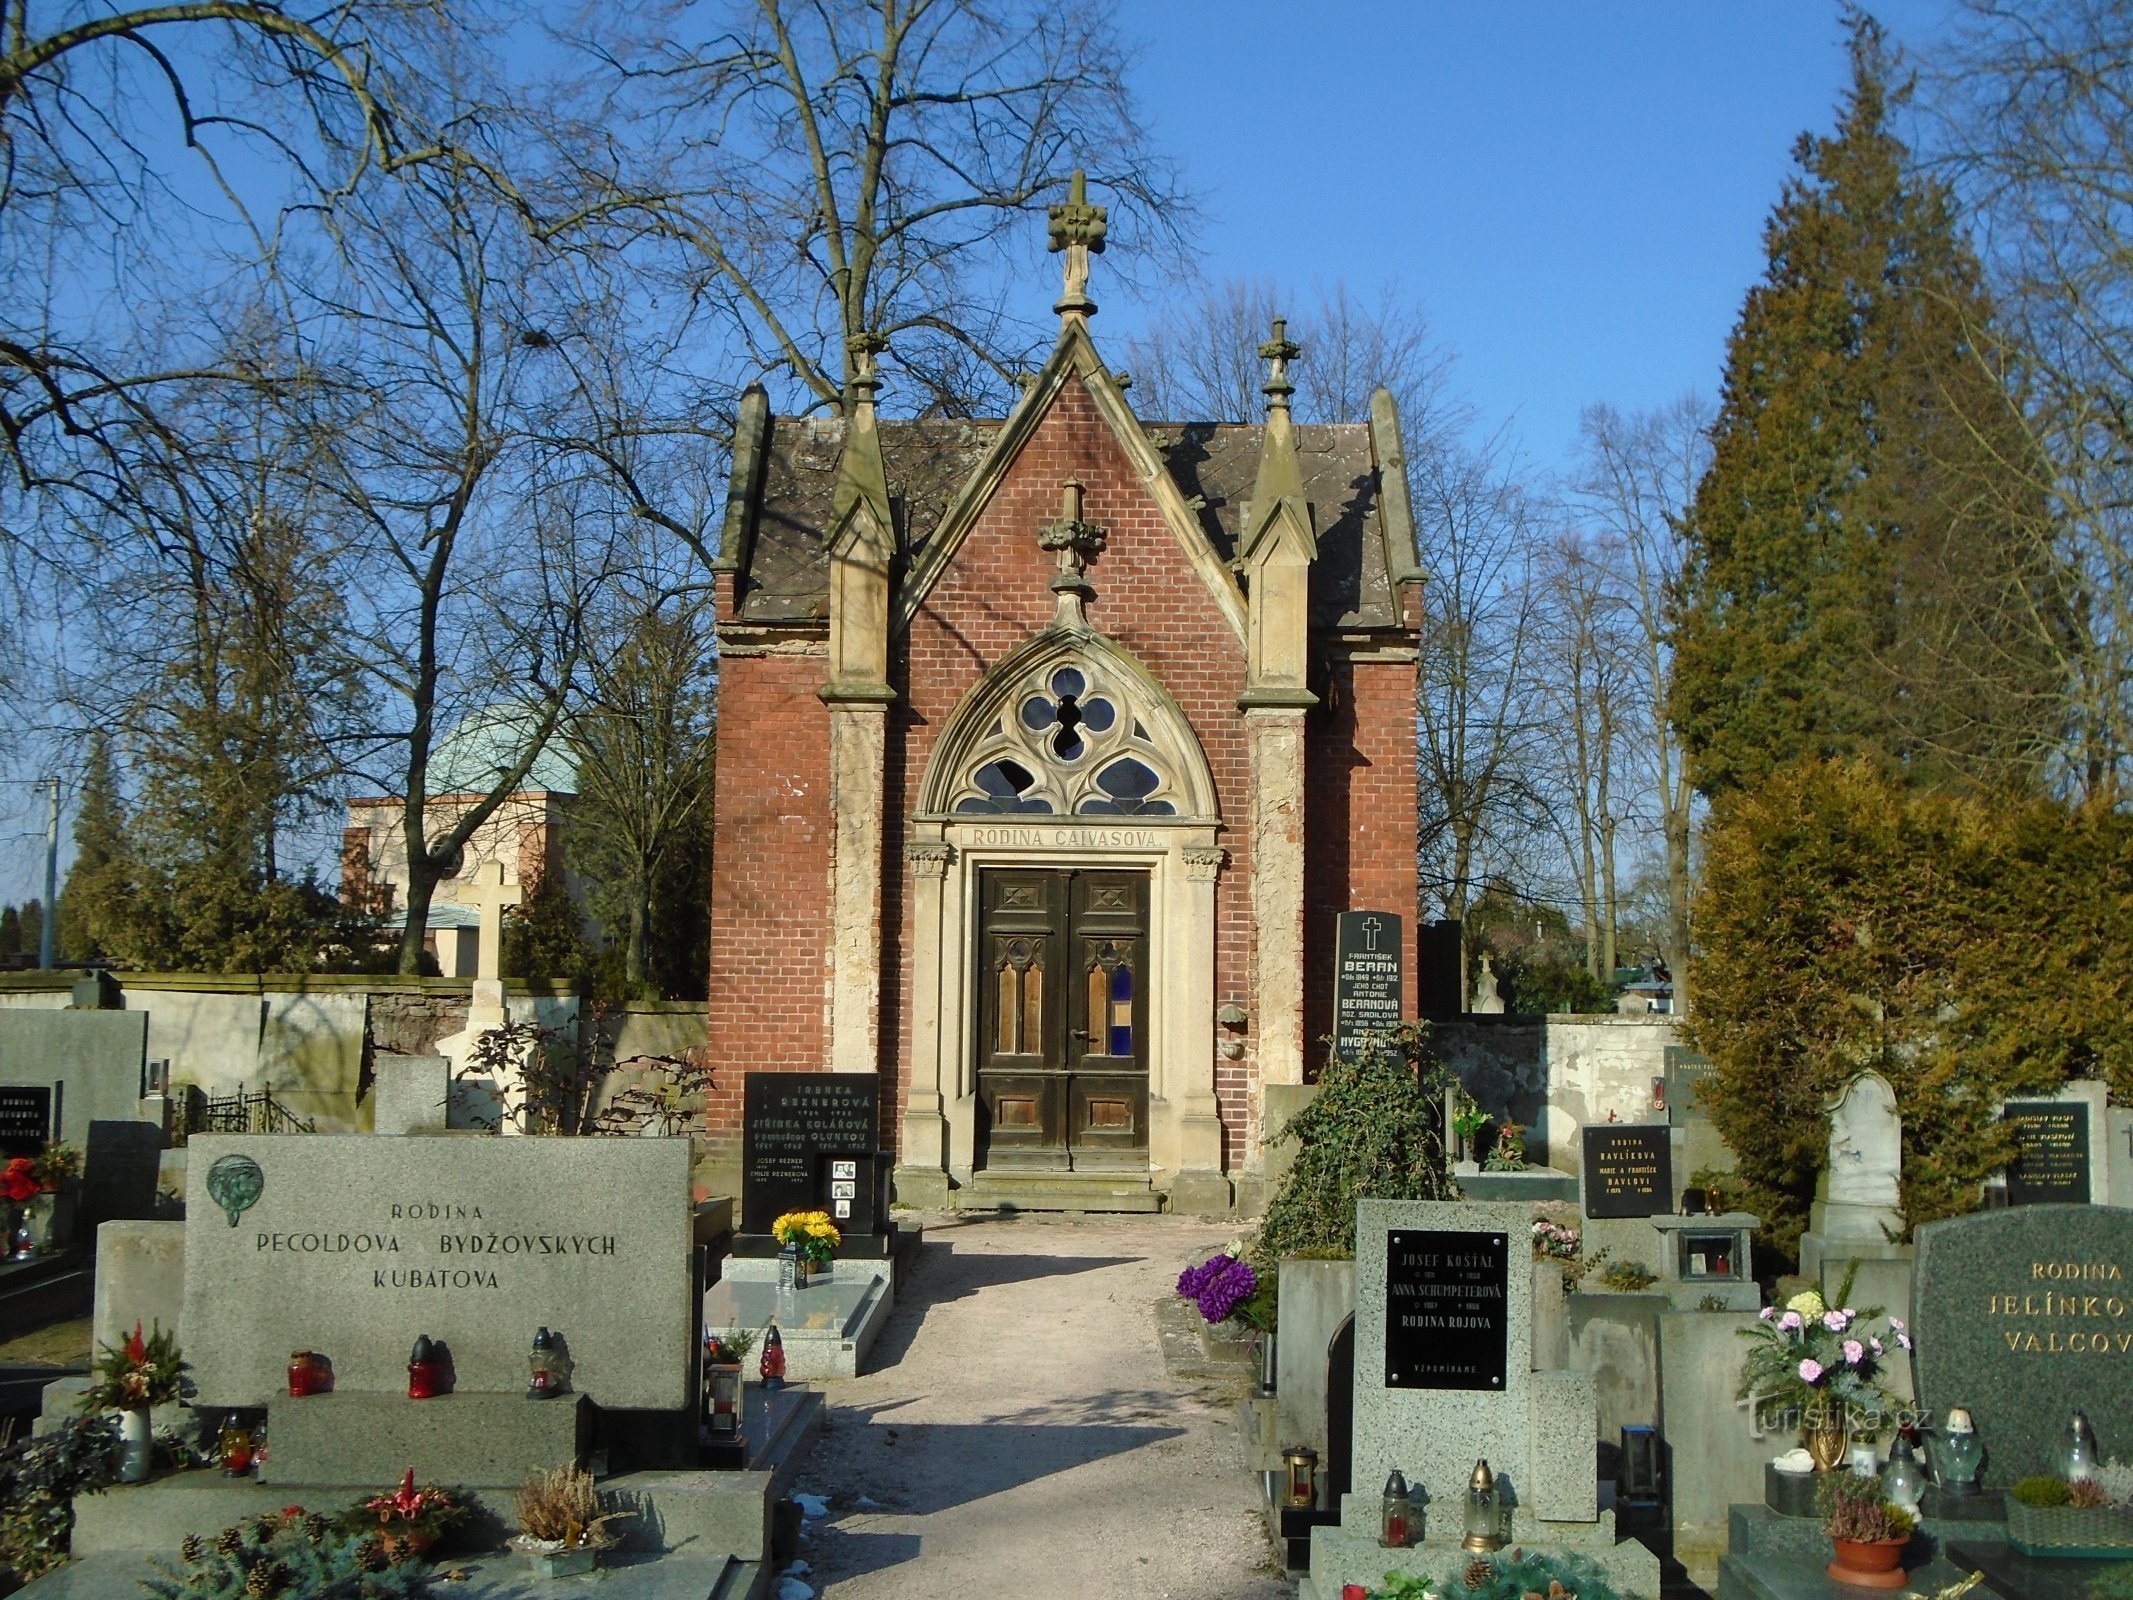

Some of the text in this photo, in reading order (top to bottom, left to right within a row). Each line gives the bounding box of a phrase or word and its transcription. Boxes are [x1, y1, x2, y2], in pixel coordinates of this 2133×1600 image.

[973, 829, 1043, 846] RODINA
[1348, 953, 1393, 961] FRANTIŠEK
[1344, 961, 1398, 973] BERAN
[1353, 990, 1388, 998] ANTONIE
[1342, 998, 1398, 1010] BERANOVÁ
[391, 1203, 482, 1219] RODINA
[256, 1234, 400, 1253] PECOLDOVA
[1402, 1254, 1439, 1266] JOSEF
[2031, 1262, 2124, 1280] RODINA
[1391, 1283, 1502, 1298] ANNA SCHUMPETEROVÁ
[1402, 1315, 1491, 1328] RODINA ROJOVA
